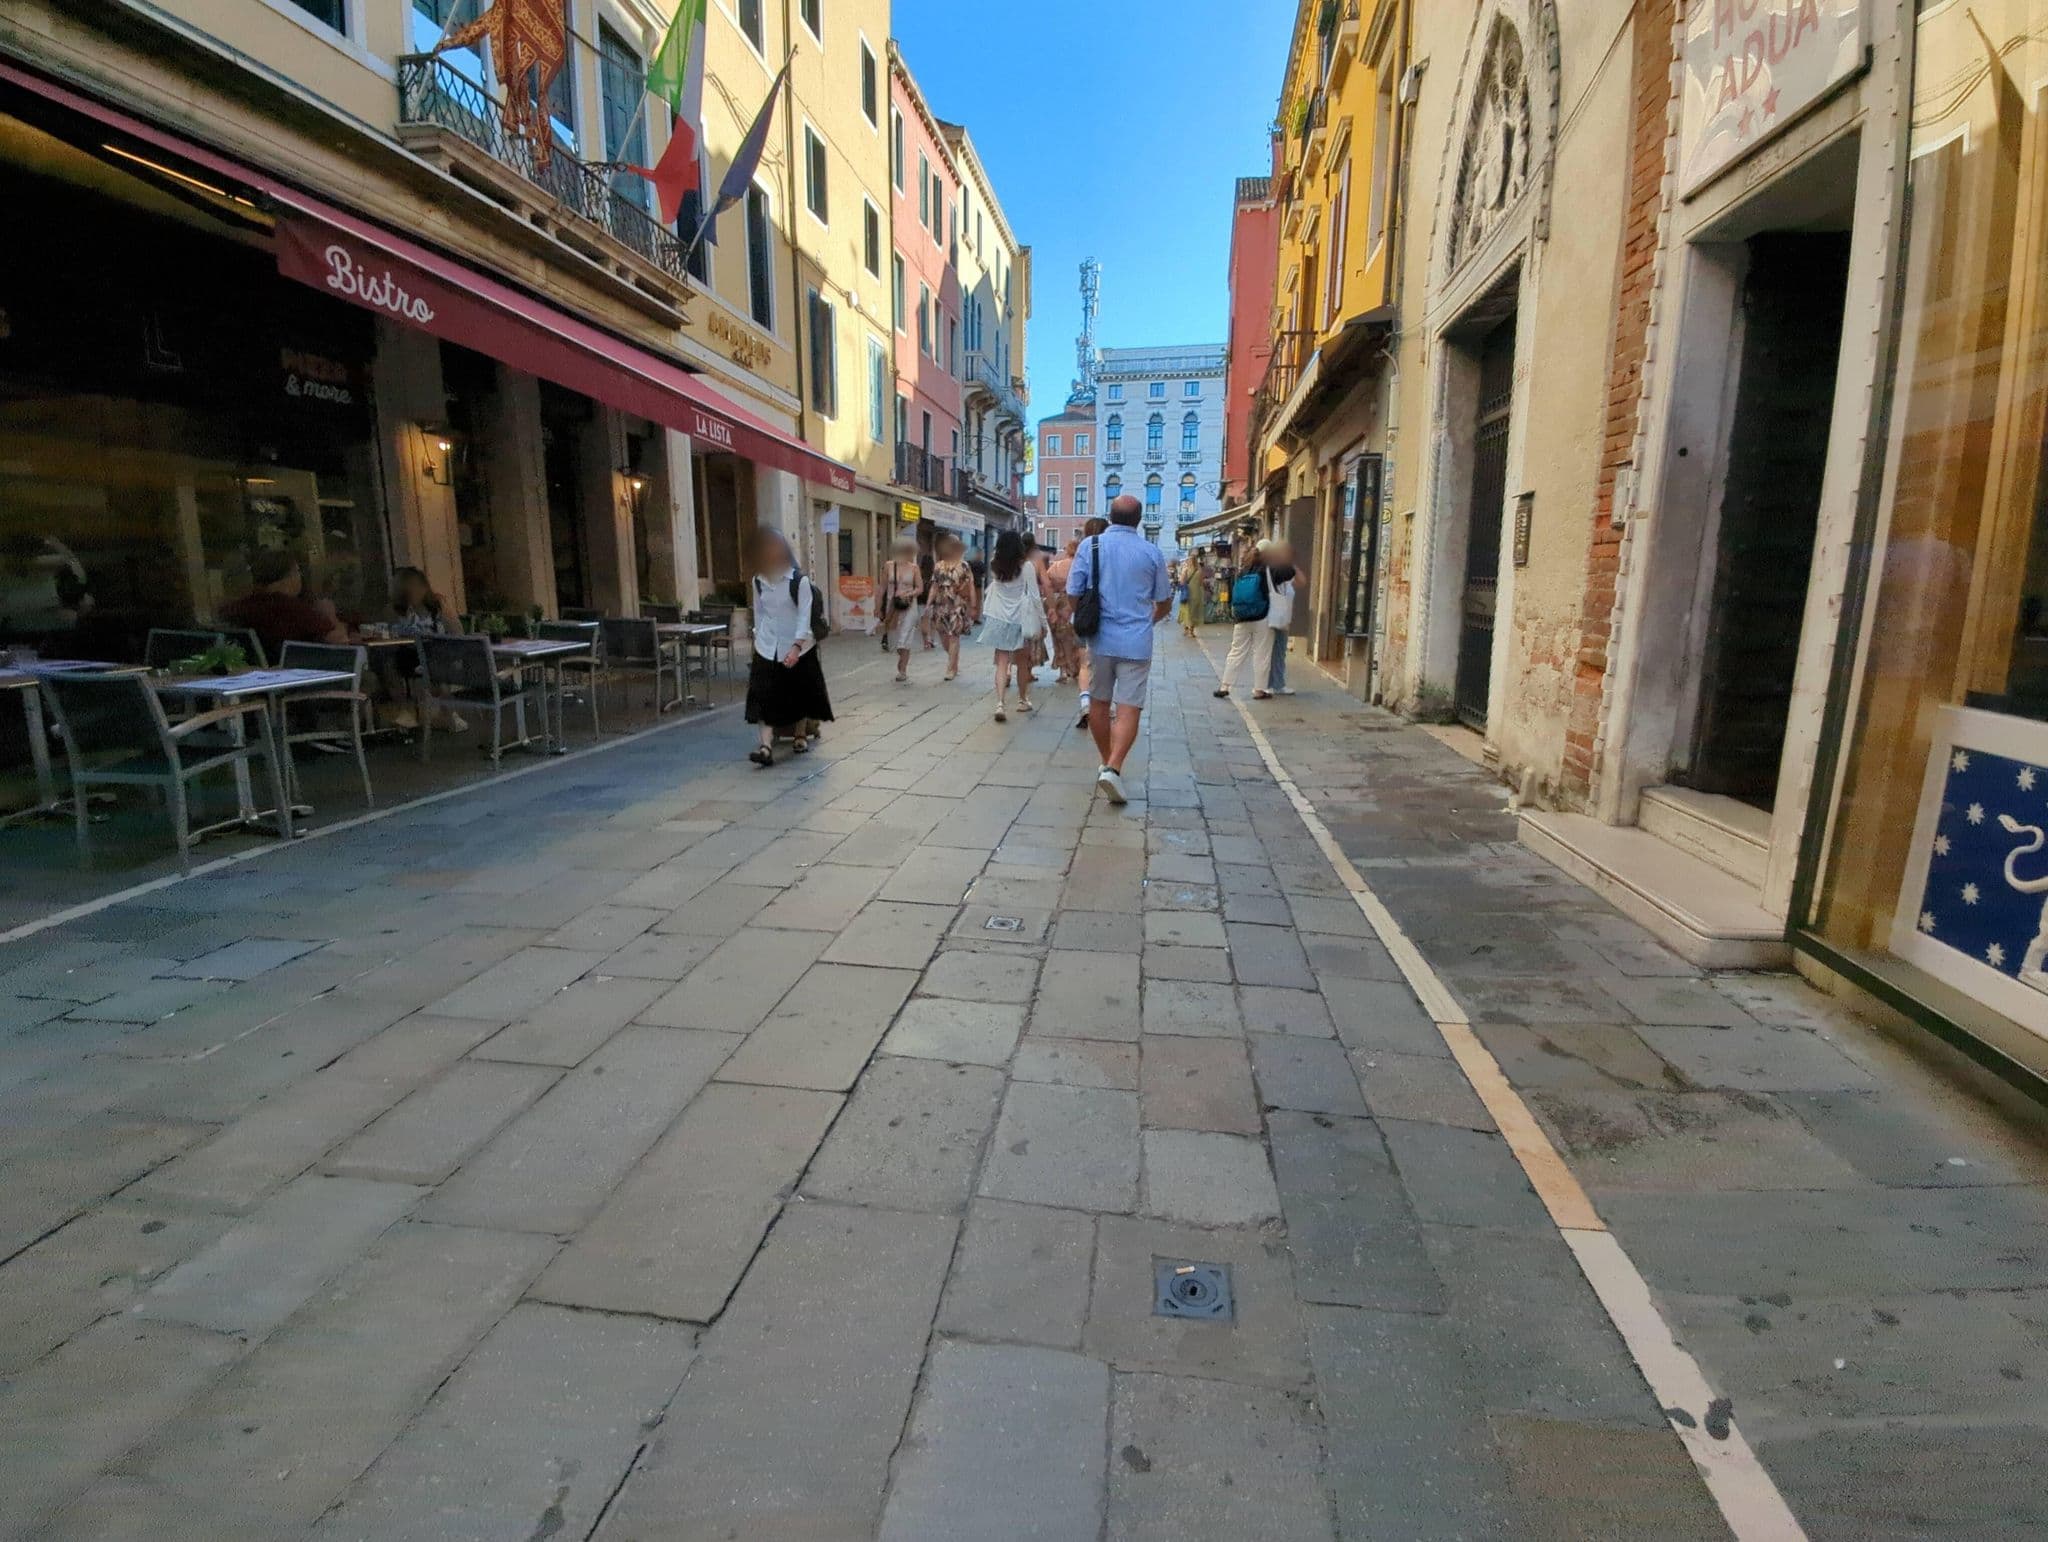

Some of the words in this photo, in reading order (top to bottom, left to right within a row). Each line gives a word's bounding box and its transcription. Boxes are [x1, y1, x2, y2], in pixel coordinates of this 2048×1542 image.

[1716, 0, 1819, 116] ADUA
[325, 245, 435, 323] Bistro
[285, 373, 300, 397] &
[302, 379, 353, 404] more
[695, 414, 708, 436] LA
[709, 420, 732, 446] LISTA
